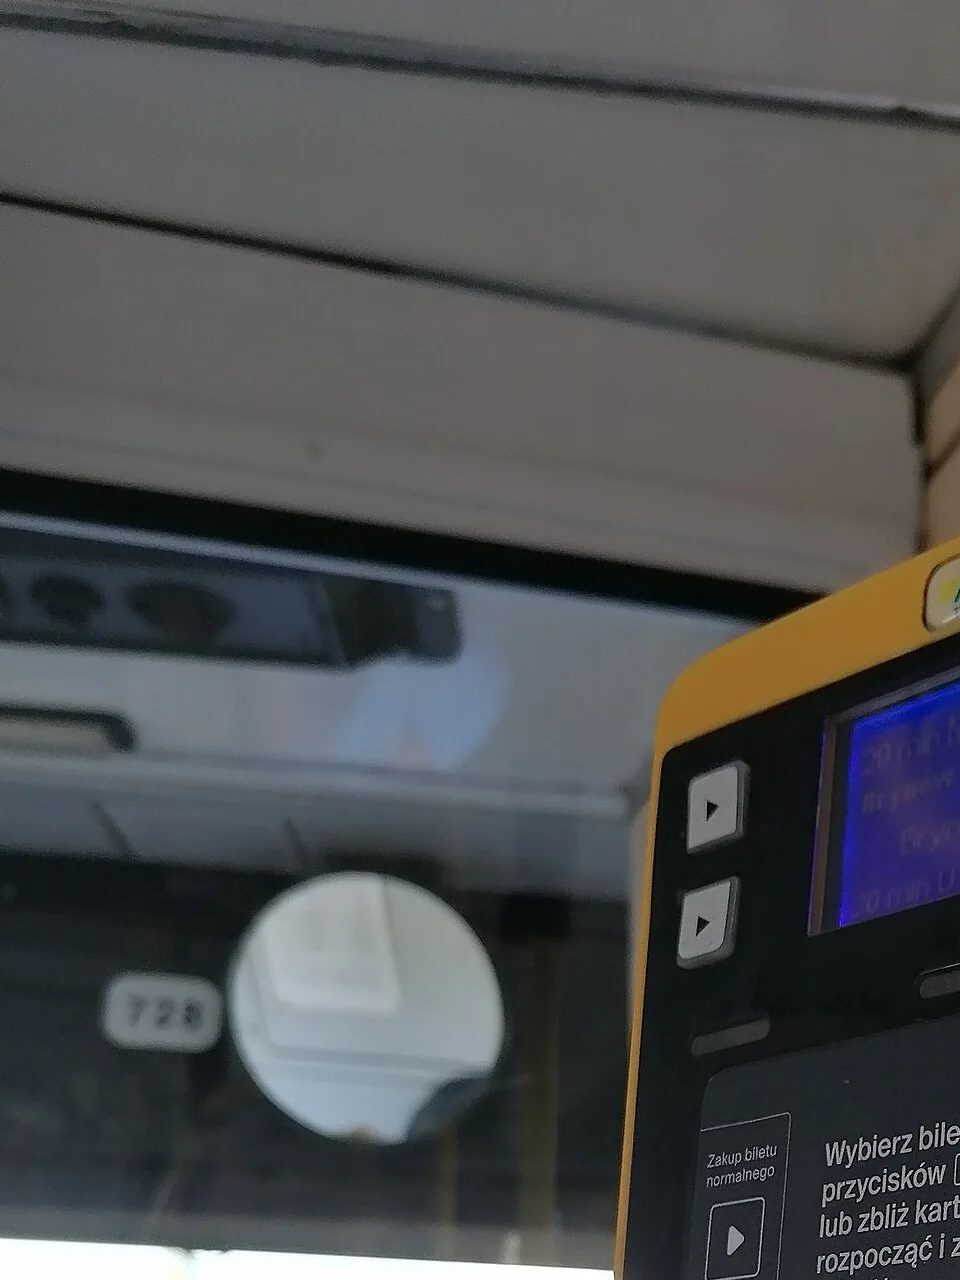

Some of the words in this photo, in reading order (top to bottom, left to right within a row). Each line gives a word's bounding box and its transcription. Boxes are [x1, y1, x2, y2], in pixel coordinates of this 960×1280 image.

[707, 1152, 743, 1169] Zakup
[745, 1143, 777, 1162] biletu
[825, 1132, 913, 1169] Wybierz
[706, 1166, 775, 1187] normalnego
[821, 1161, 947, 1208] przycisków
[819, 1211, 853, 1238] lub
[857, 1203, 909, 1234] zbliż
[816, 1234, 933, 1276] rozpocząć
[938, 1233, 946, 1259] i
